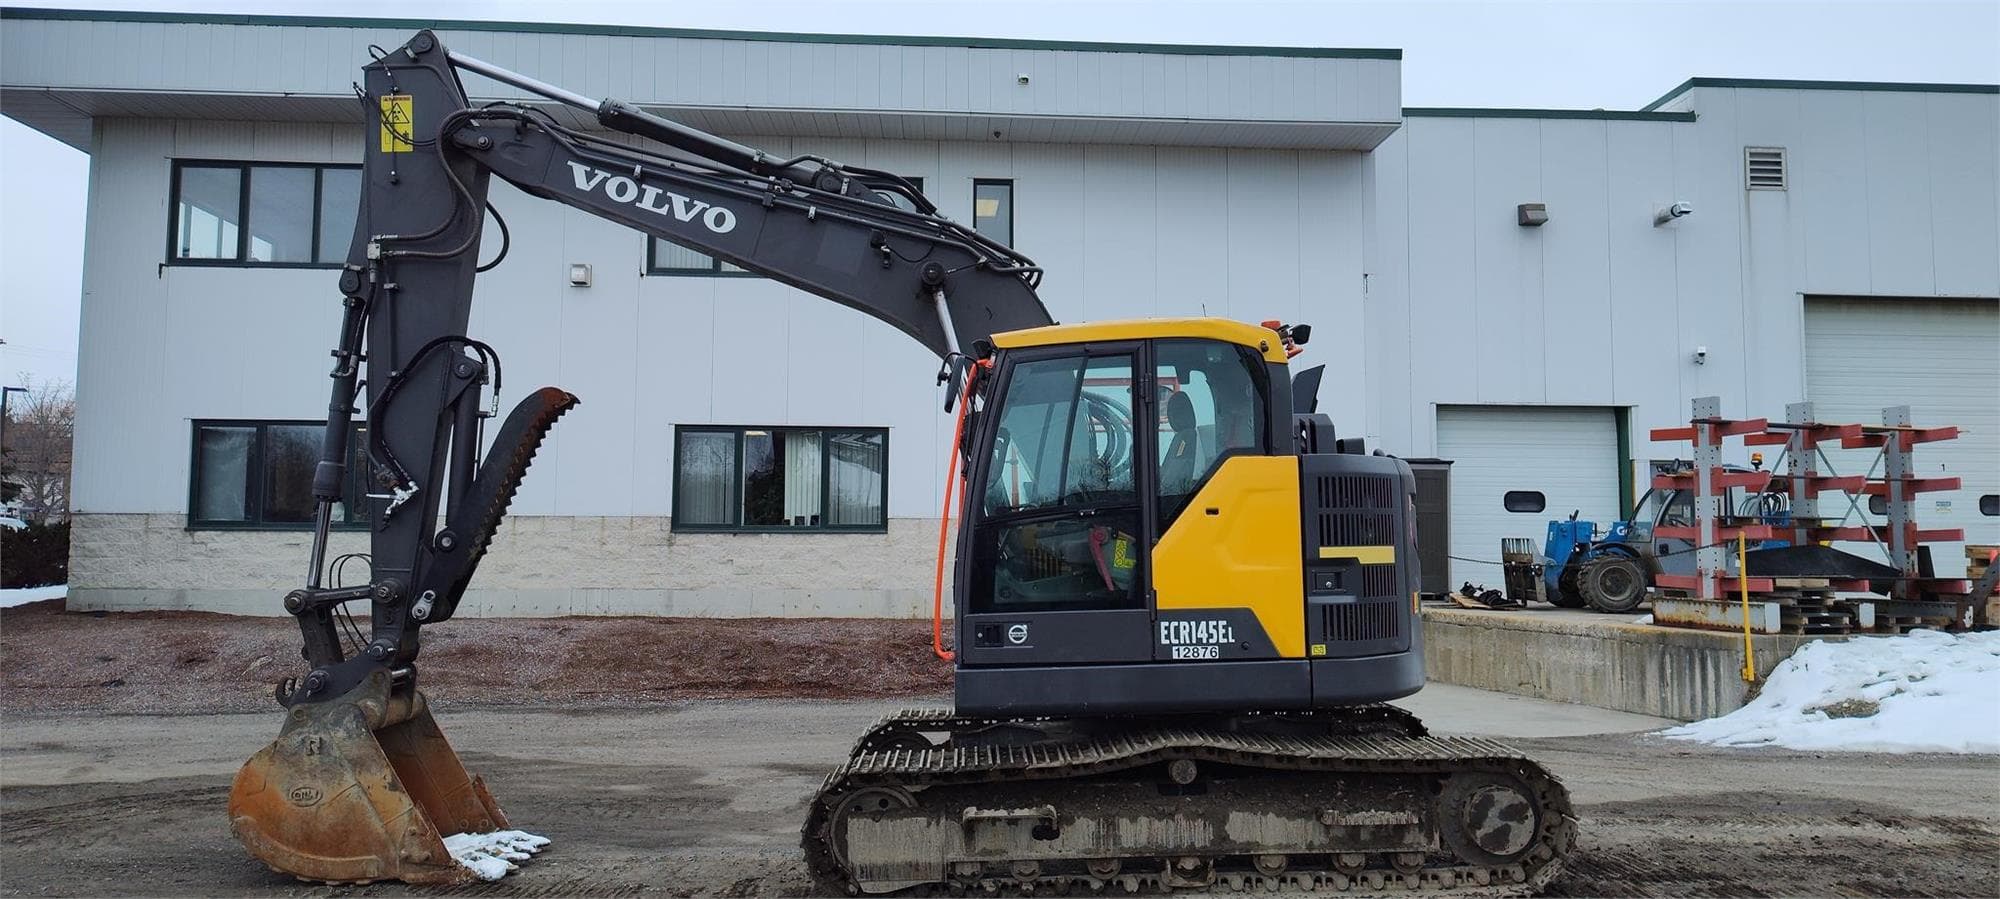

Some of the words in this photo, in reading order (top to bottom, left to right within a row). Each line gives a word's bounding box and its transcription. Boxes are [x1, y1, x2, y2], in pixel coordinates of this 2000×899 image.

[567, 160, 737, 234] VOLVO
[1160, 620, 1236, 645] ECR145EL
[1174, 646, 1218, 658] 12876
